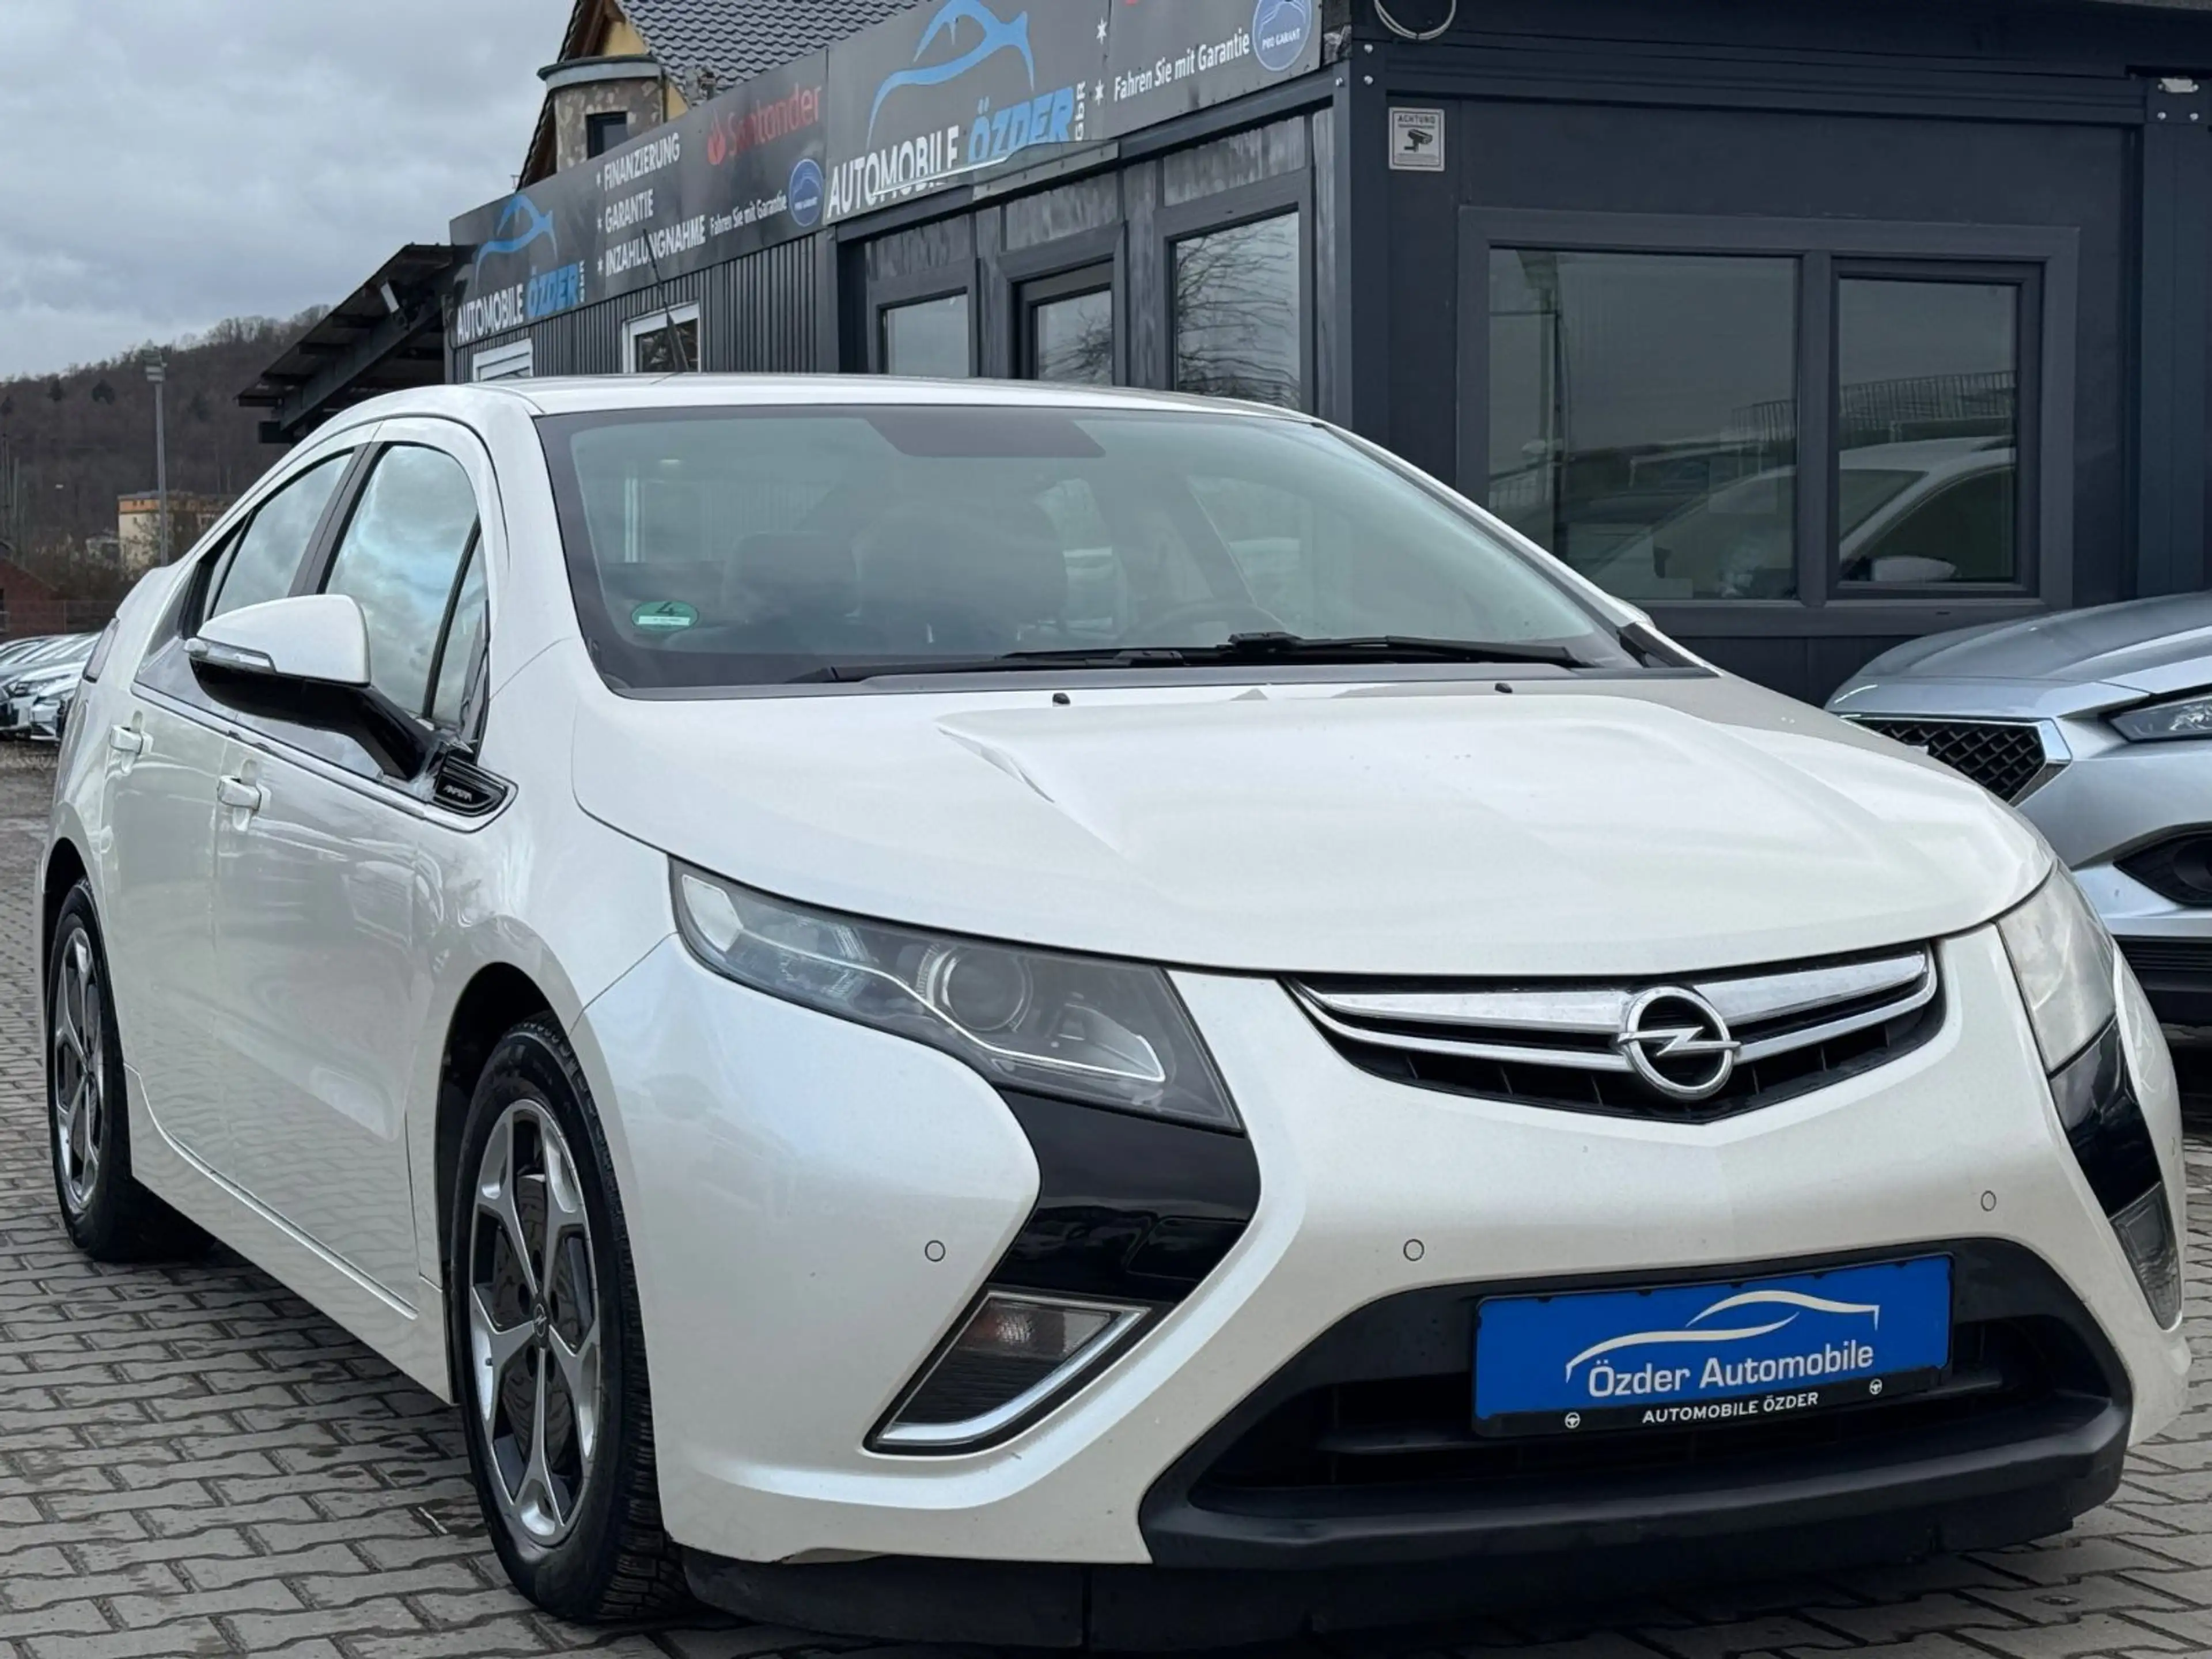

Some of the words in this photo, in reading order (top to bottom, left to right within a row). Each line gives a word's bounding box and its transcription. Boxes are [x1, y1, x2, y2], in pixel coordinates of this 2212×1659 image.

[1113, 69, 1153, 102] Fahren
[1154, 56, 1172, 87] Sie
[1174, 47, 1195, 80] mit
[1198, 27, 1250, 71] Garantie
[728, 82, 822, 156] Santander
[604, 132, 680, 191] FINANZIERUNG
[826, 124, 960, 219] AUTOMOBILE
[968, 86, 1074, 165] ÖZDER
[605, 188, 654, 233] GARANTIE
[710, 213, 732, 237] Fahren
[732, 206, 743, 229] Sie
[744, 200, 757, 224] mit
[756, 190, 787, 220] Garantie
[605, 214, 706, 278] INZAHLUNGNAHME
[457, 283, 524, 346] AUTOMOBILE
[527, 263, 578, 320] ÖZDER
[656, 602, 677, 616] 4
[1588, 1359, 1691, 1398] Özder
[1698, 1339, 1874, 1389] Automobile
[1642, 1400, 1759, 1424] AUTOMOBILE
[1762, 1391, 1819, 1414] ÖZDER
